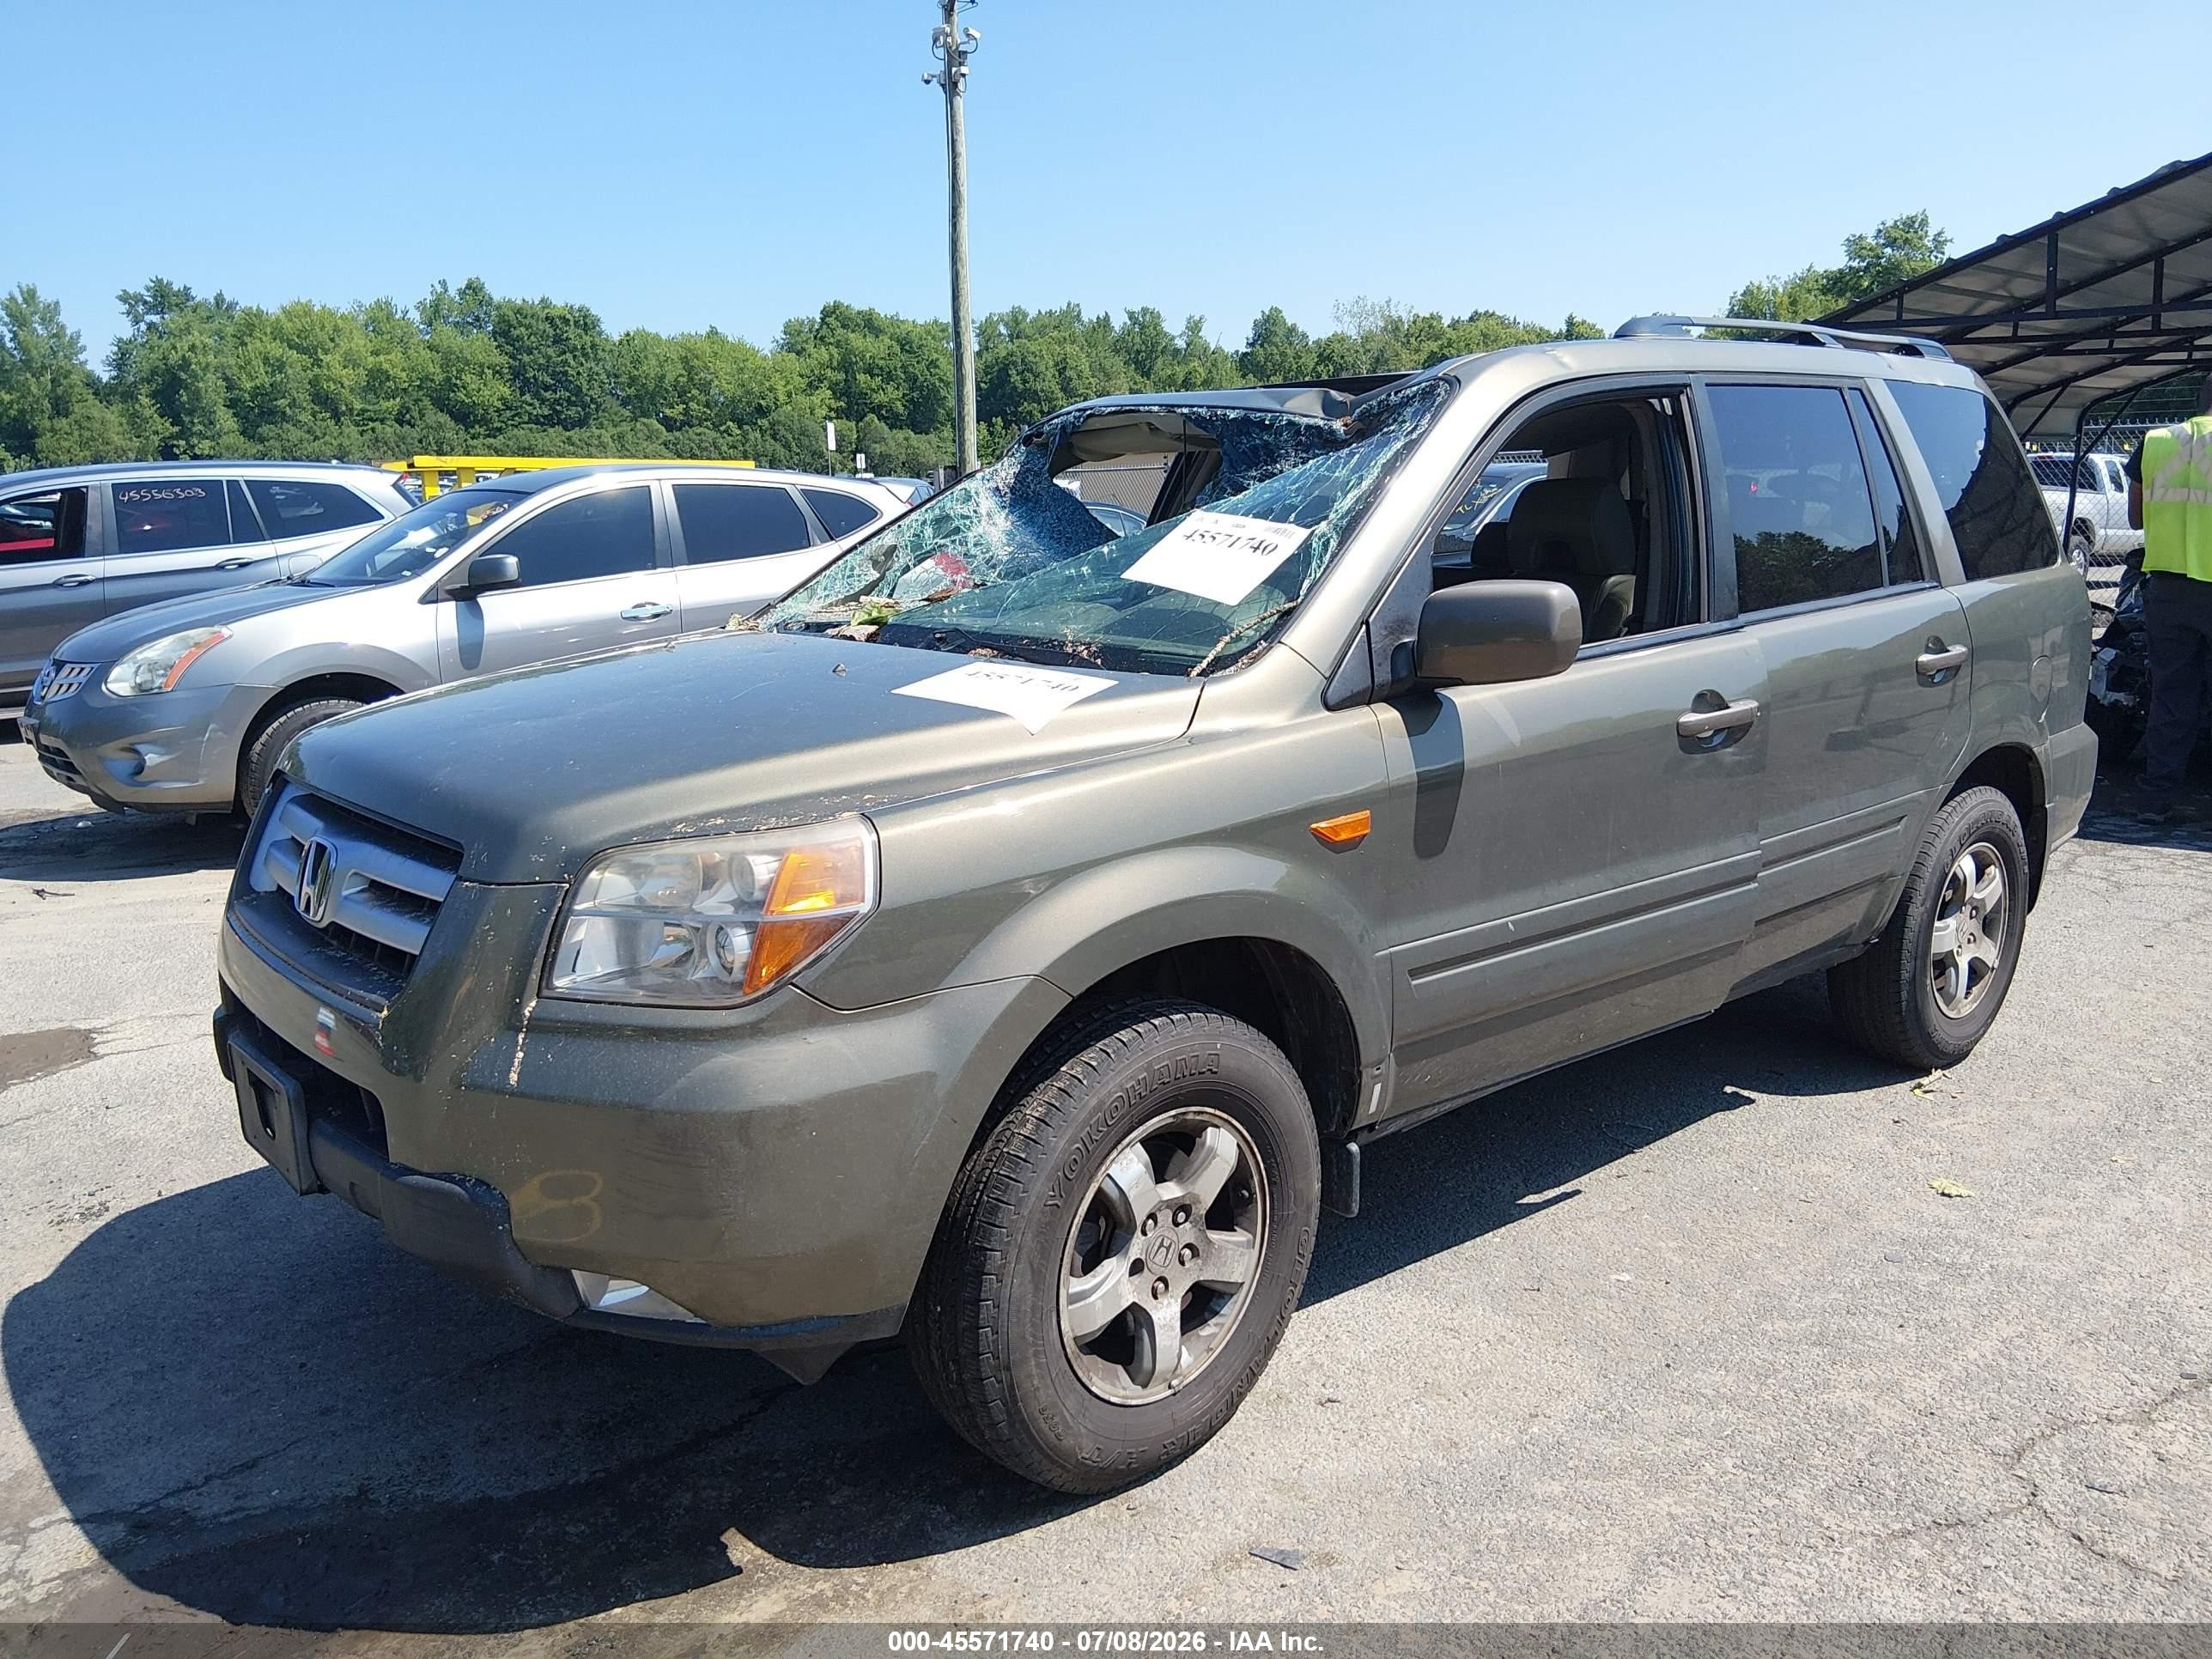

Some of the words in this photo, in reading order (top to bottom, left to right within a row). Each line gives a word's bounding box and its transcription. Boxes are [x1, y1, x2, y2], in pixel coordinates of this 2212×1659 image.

[118, 487, 207, 503] 45556303
[1182, 527, 1279, 556] 45571740
[1044, 1050, 1220, 1209] YOKOHAMA
